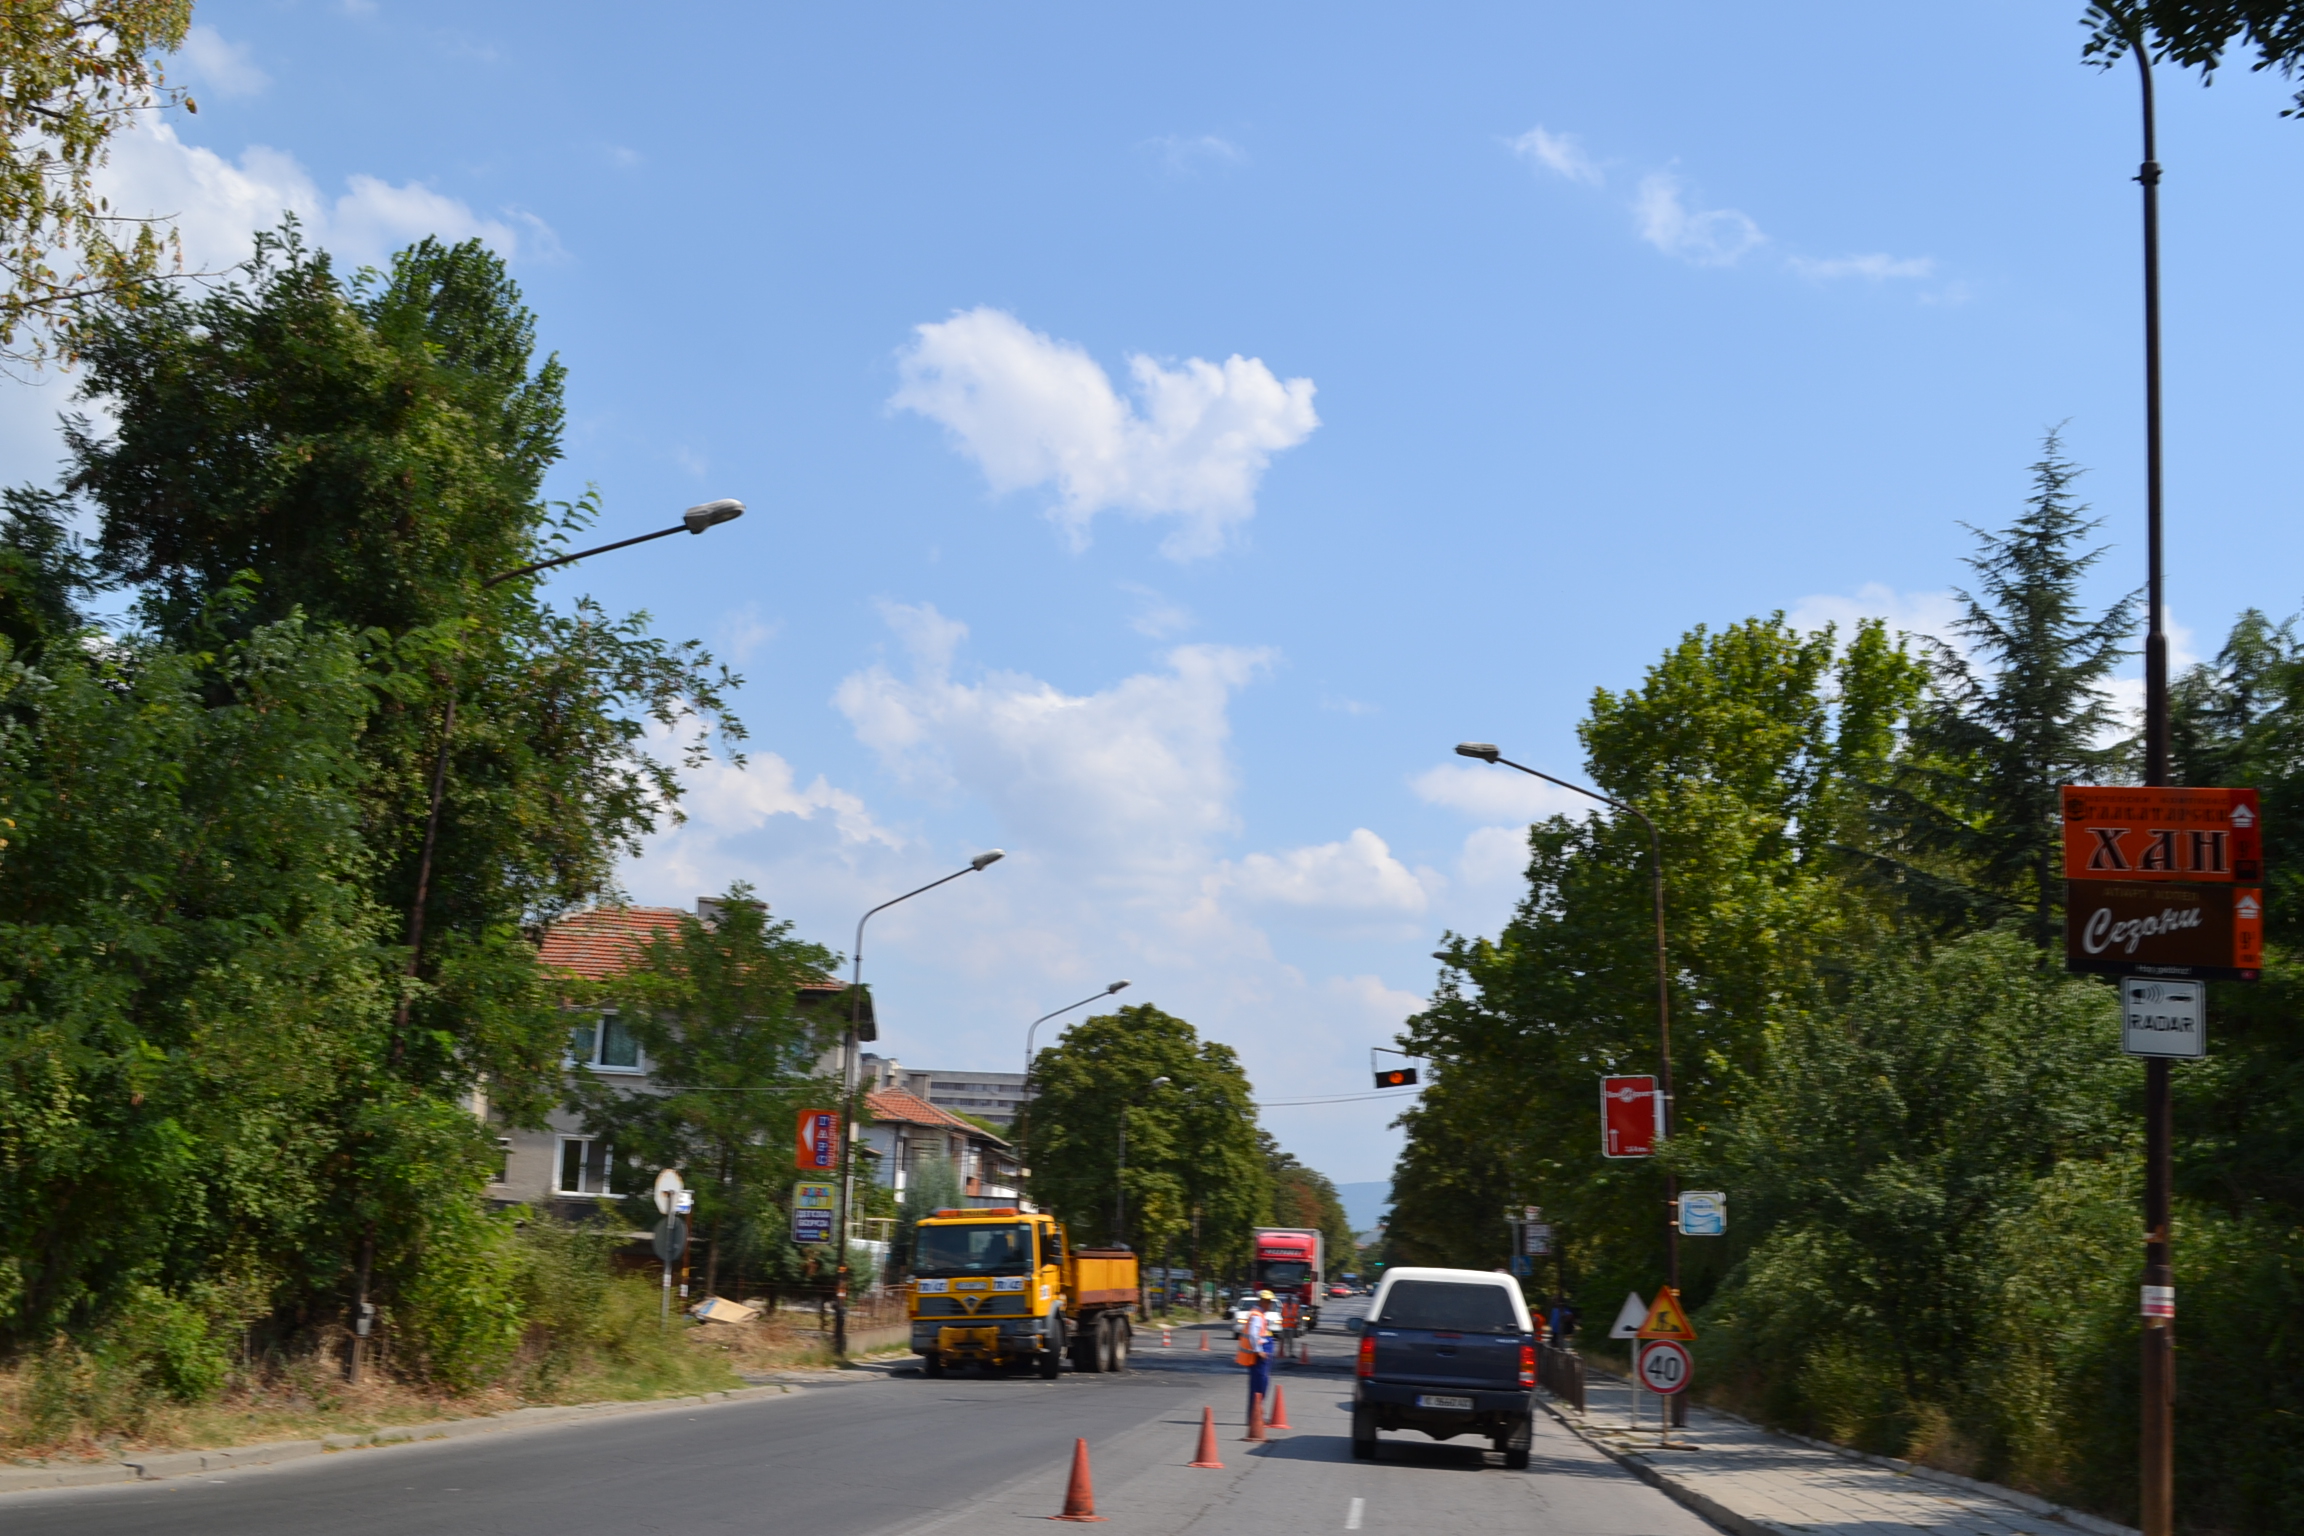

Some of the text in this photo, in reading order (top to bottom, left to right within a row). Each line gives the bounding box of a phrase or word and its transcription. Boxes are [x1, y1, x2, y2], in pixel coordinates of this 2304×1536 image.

[2085, 827, 2230, 874] ХАН
[2082, 907, 2203, 954] Сезони
[2128, 1013, 2195, 1032] RADAR
[1647, 1355, 1681, 1381] 40
